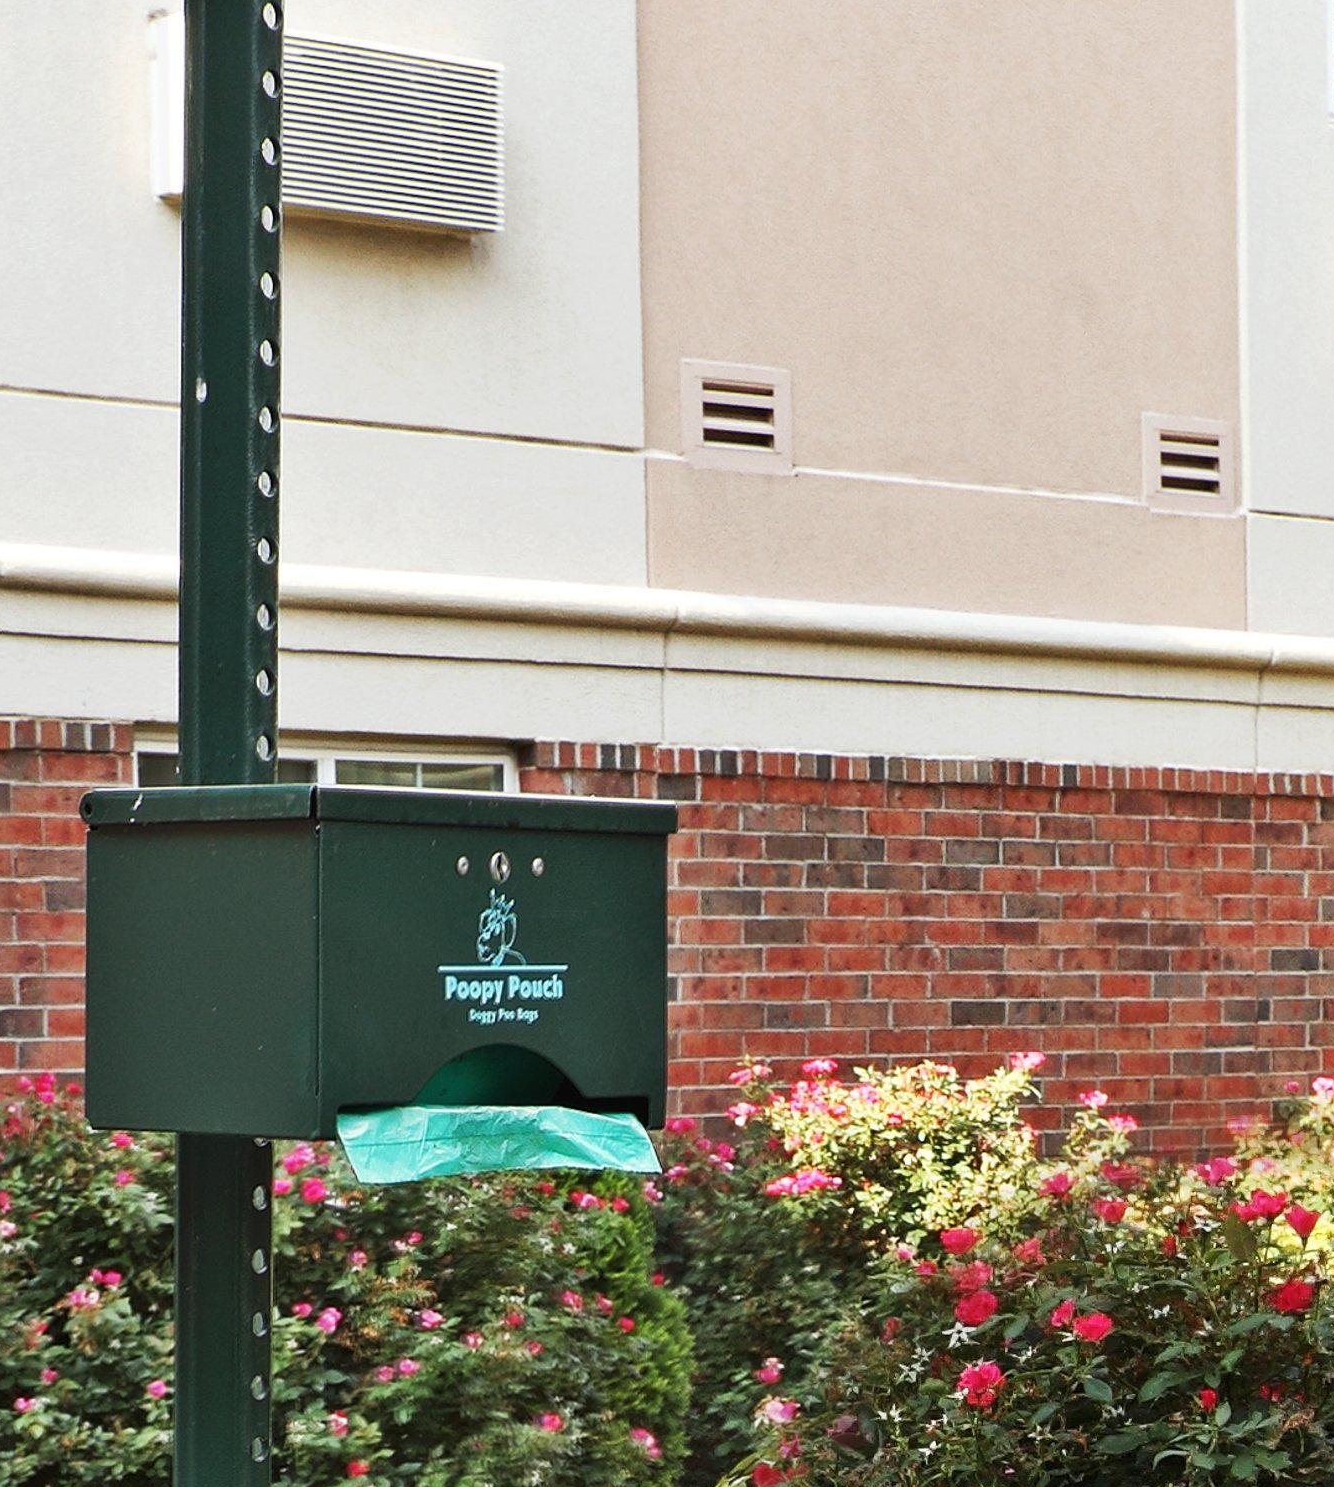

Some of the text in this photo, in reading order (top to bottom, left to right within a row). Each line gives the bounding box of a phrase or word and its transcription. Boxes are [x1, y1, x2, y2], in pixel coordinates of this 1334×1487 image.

[444, 973, 564, 1005] Poopy Pouch
[468, 1007, 539, 1025] Doggy Poo Bags
